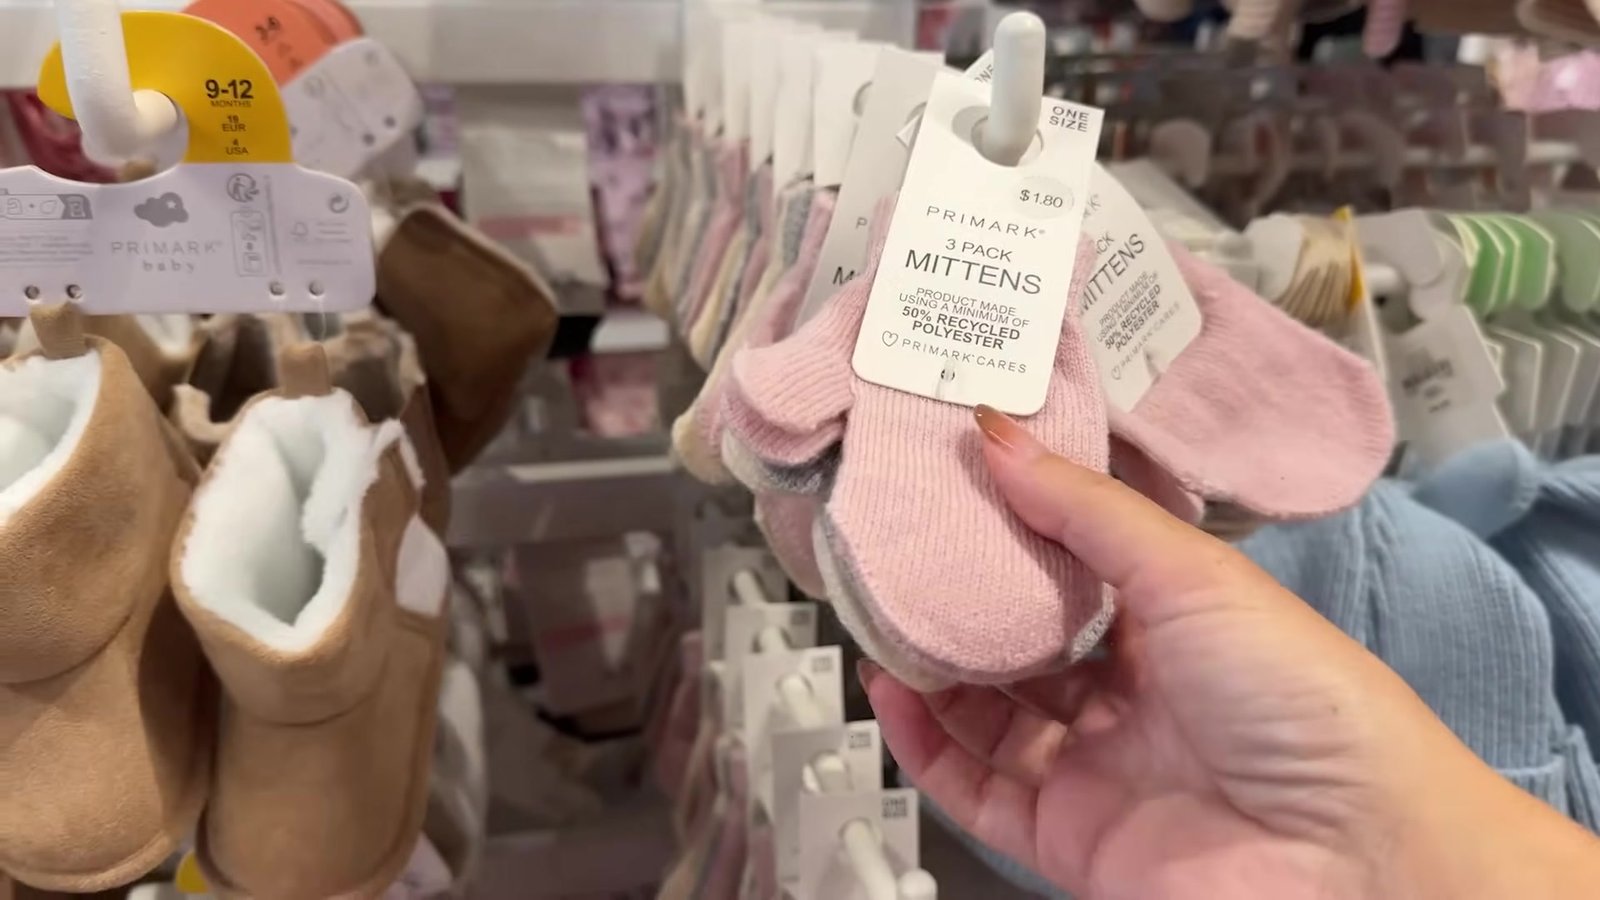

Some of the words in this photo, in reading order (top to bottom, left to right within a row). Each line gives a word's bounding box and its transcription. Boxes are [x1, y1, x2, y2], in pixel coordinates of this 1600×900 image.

[205, 79, 254, 99] 9-12
[210, 100, 252, 108] MONTHS
[1052, 106, 1089, 122] ONE
[222, 123, 247, 132] EUR
[1049, 115, 1088, 132] SIZE
[226, 146, 249, 155] USA
[1020, 189, 1063, 208] $1.80
[945, 238, 956, 250] 3
[962, 241, 1013, 262] PACK
[143, 260, 194, 274] baby
[905, 249, 1041, 295] MITTENS
[899, 293, 938, 309] USING
[940, 302, 949, 312] A
[952, 305, 1009, 325] MINIMUM
[1012, 317, 1030, 328] OF
[916, 287, 977, 308] PRODUCT
[979, 300, 1017, 317] MADE
[1120, 284, 1160, 331] RECYCLED
[902, 305, 932, 322] 50%
[936, 313, 1020, 340] RECYCLED
[1115, 300, 1160, 352] POLYESTER
[912, 320, 1004, 350] POLYESTER
[976, 355, 1027, 374] CARES
